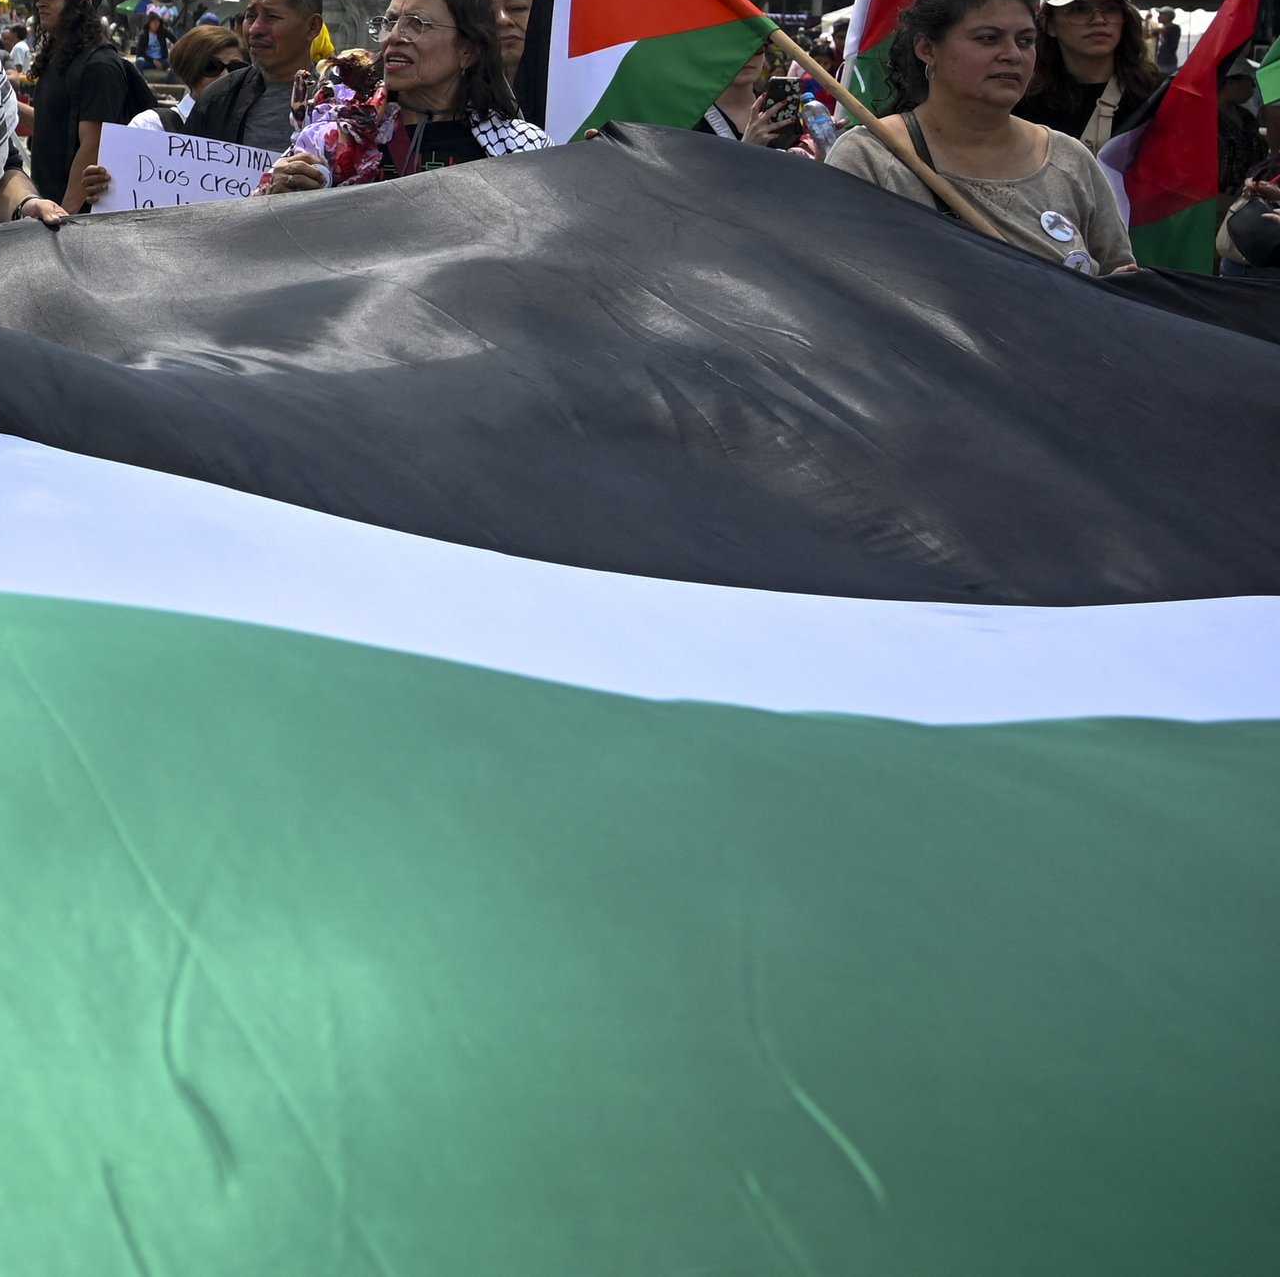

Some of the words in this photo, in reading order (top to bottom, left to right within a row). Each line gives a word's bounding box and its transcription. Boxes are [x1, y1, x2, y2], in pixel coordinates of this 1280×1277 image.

[168, 135, 273, 172] PALESTINA
[138, 154, 190, 186] Dios
[200, 173, 251, 198] creó
